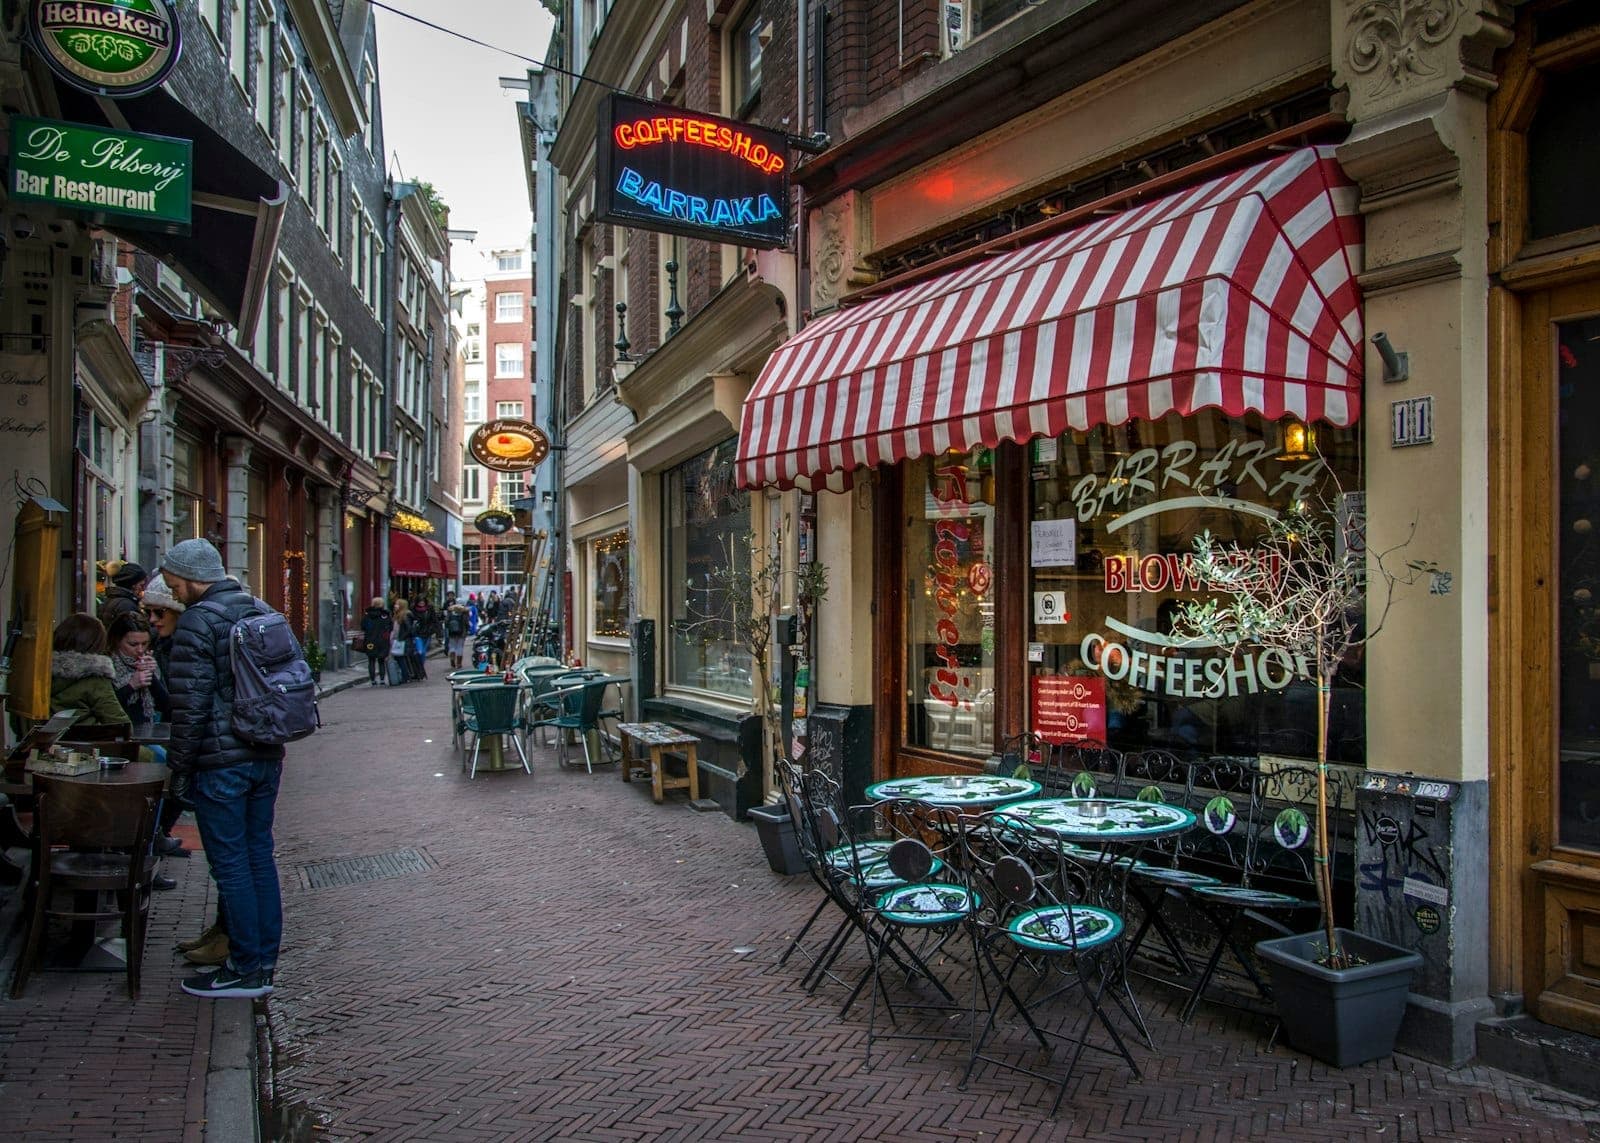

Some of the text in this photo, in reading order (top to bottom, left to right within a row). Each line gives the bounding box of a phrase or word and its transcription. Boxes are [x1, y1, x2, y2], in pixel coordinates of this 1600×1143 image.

[44, 2, 165, 41] Heineken
[18, 127, 185, 191] De Pilserij
[615, 117, 785, 175] COFFEESHOP
[16, 170, 156, 212] Bar Restaurant
[616, 167, 782, 227] BARRAKA
[1397, 402, 1426, 440] 11
[1071, 439, 1327, 523] BARRAKA
[971, 562, 988, 588] 18
